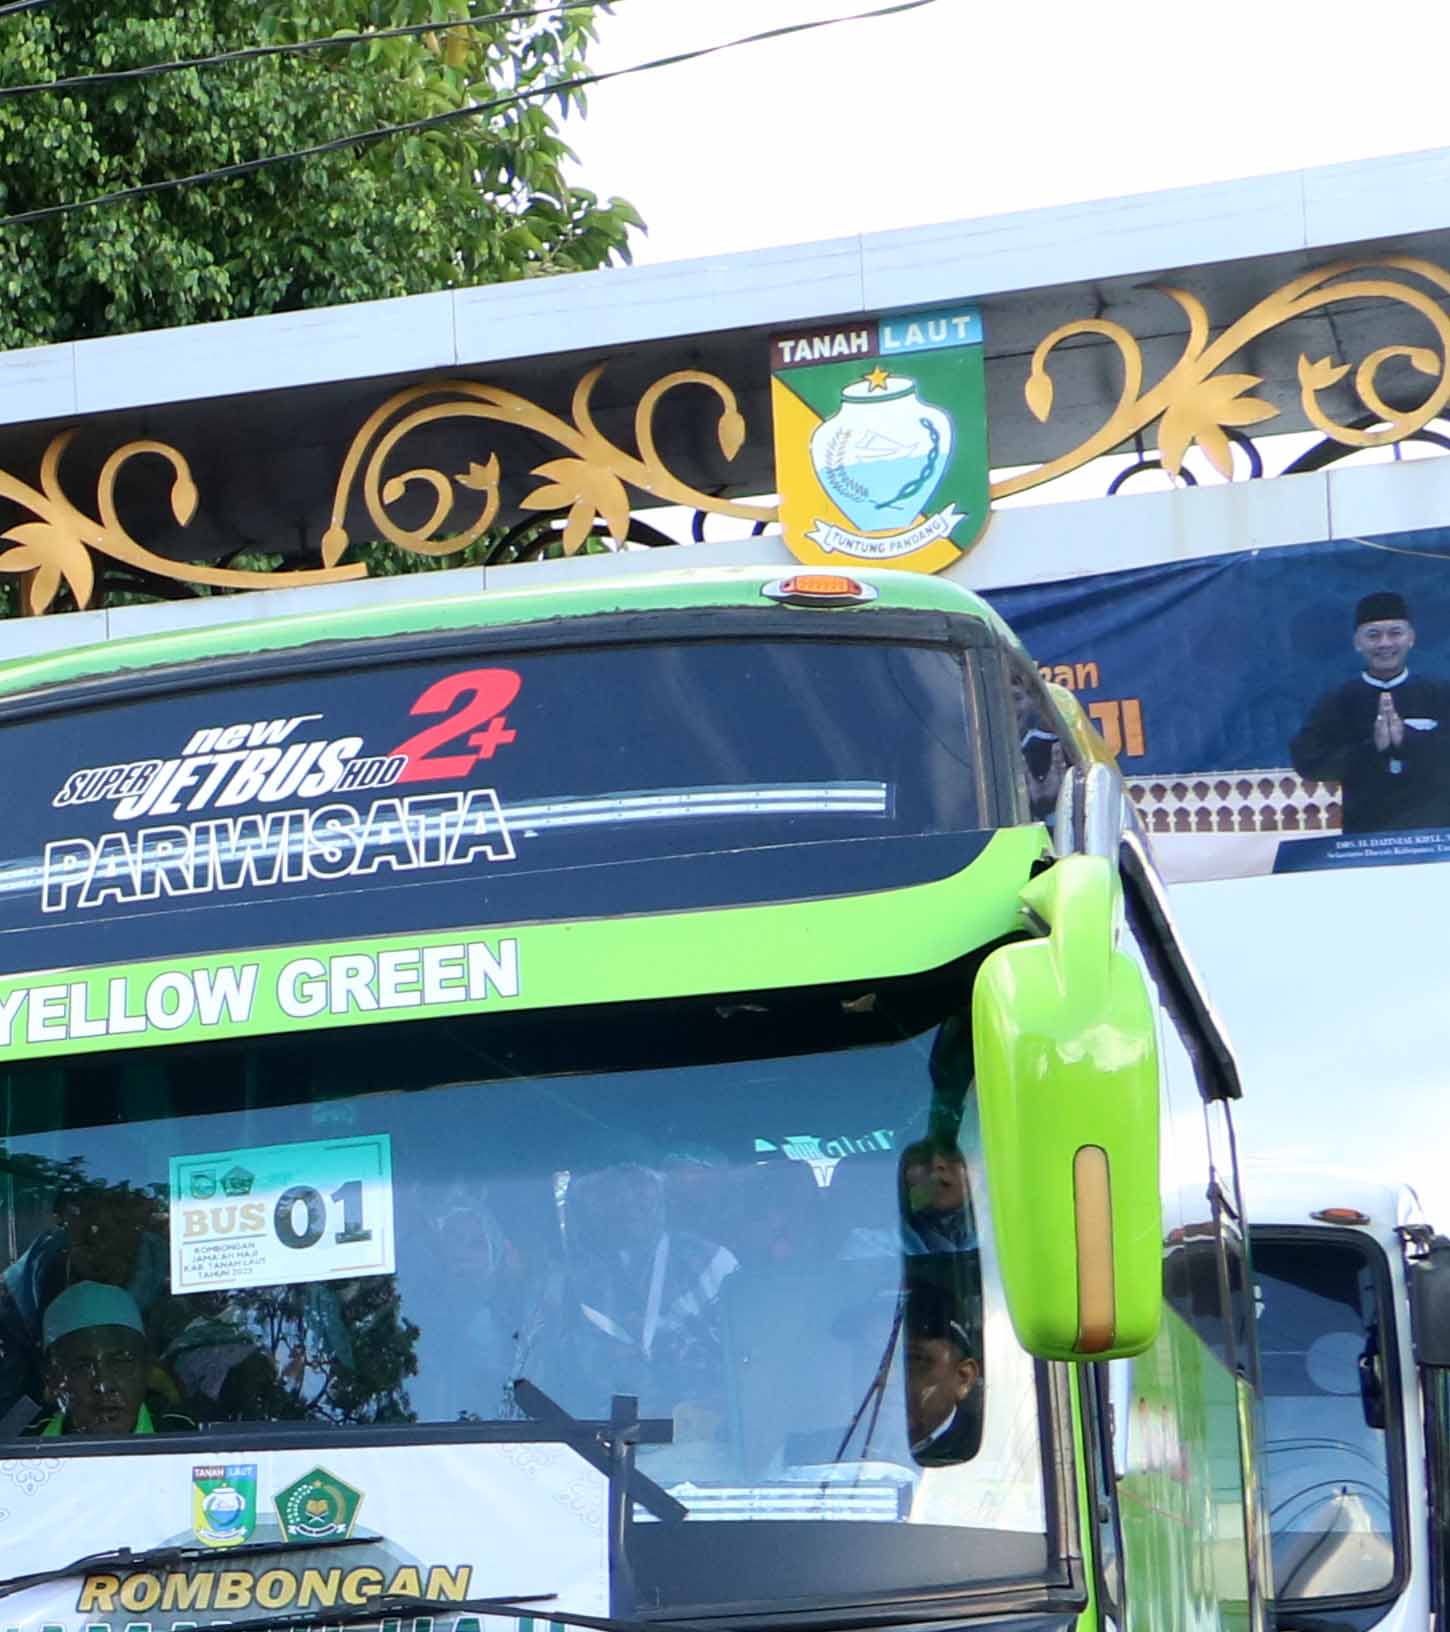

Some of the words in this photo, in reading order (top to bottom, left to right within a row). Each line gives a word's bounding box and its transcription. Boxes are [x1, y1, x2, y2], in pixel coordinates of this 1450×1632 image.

[778, 330, 868, 363] TANAH
[883, 316, 971, 349] LAUT
[832, 532, 886, 553] TUNTUNG
[889, 519, 942, 551] PANDANG
[182, 714, 324, 756] new
[1088, 699, 1146, 757] JI
[52, 759, 161, 807] SUPER
[113, 736, 364, 820] JETBUS
[41, 789, 517, 913] PARIWISATA
[276, 938, 519, 1018] GREEN
[182, 1202, 267, 1238] BUS
[273, 1180, 373, 1249] 01
[76, 1565, 473, 1613] ROMBONGAN
